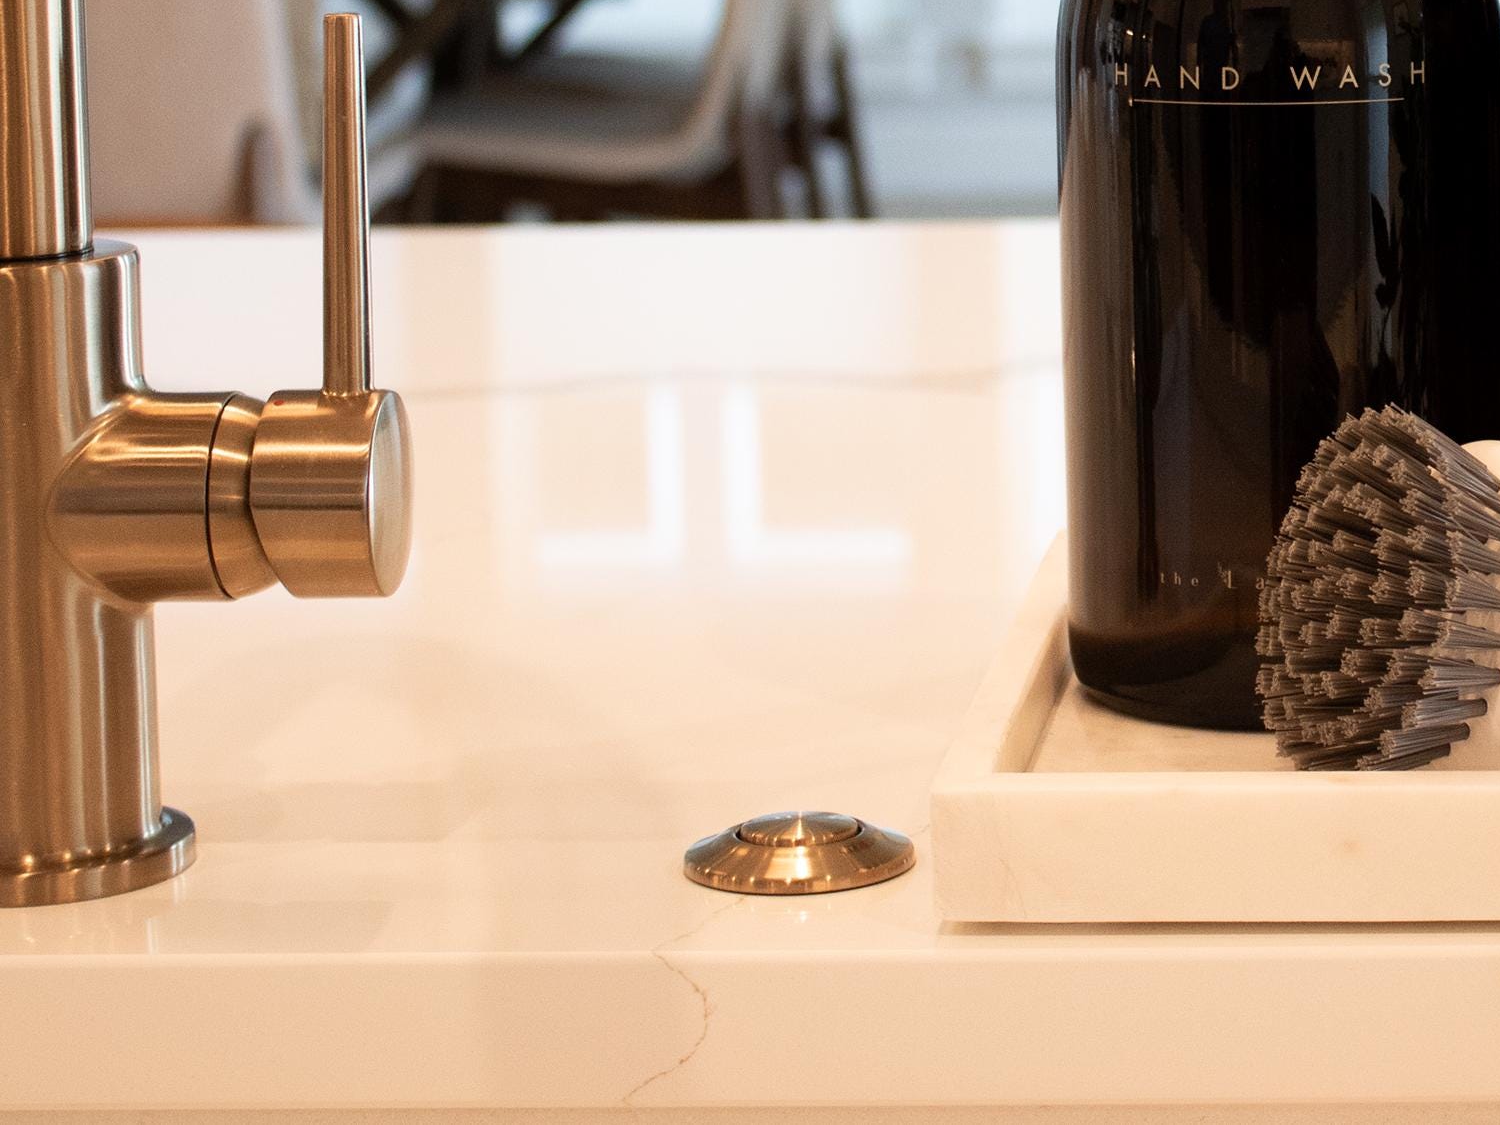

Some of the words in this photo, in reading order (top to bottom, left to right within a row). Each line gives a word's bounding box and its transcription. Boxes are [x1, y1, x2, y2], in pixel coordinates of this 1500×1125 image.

[1114, 62, 1240, 91] HAND
[1289, 61, 1426, 91] WASH
[1160, 571, 1199, 587] the
[1226, 570, 1265, 590] La
